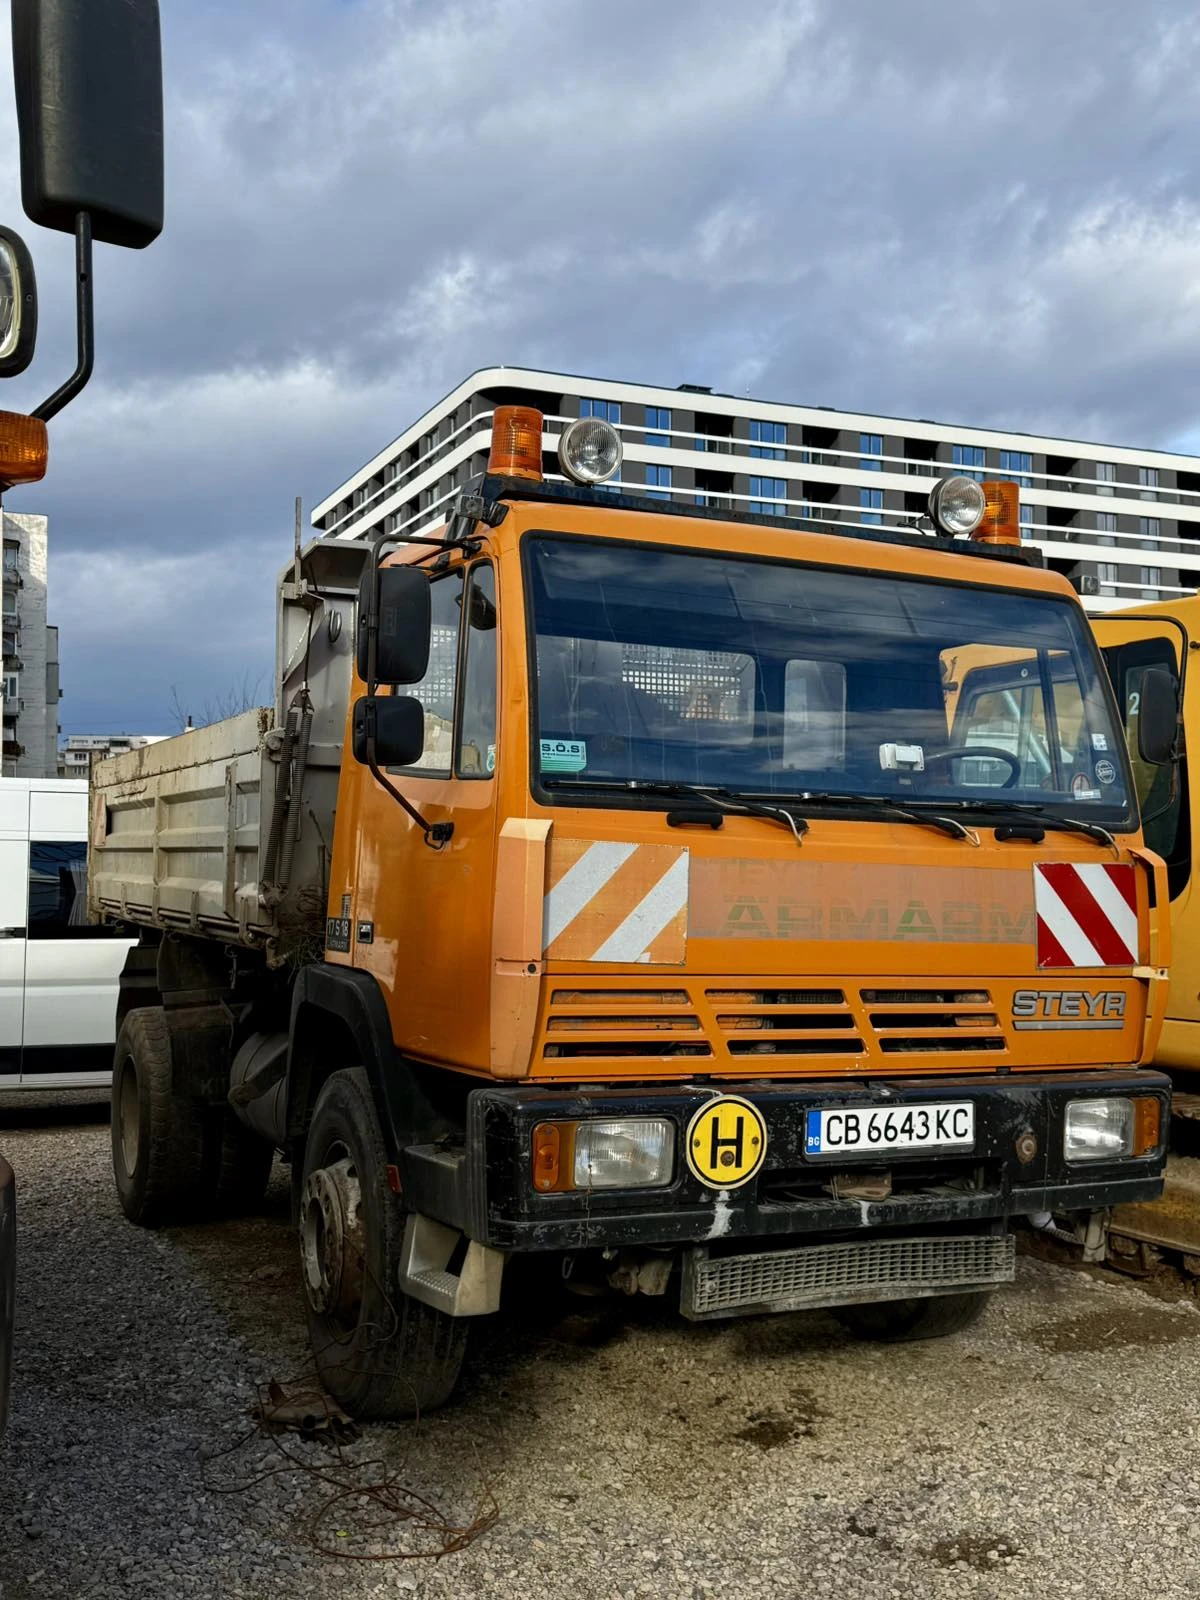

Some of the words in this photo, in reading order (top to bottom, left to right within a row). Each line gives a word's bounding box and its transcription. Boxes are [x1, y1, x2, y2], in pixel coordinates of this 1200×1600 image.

[1012, 990, 1126, 1016] STEYR
[710, 1116, 744, 1169] H
[808, 1137, 820, 1146] BG
[826, 1114, 861, 1146] CB
[867, 1110, 930, 1143] 6643
[936, 1108, 968, 1139] KC
